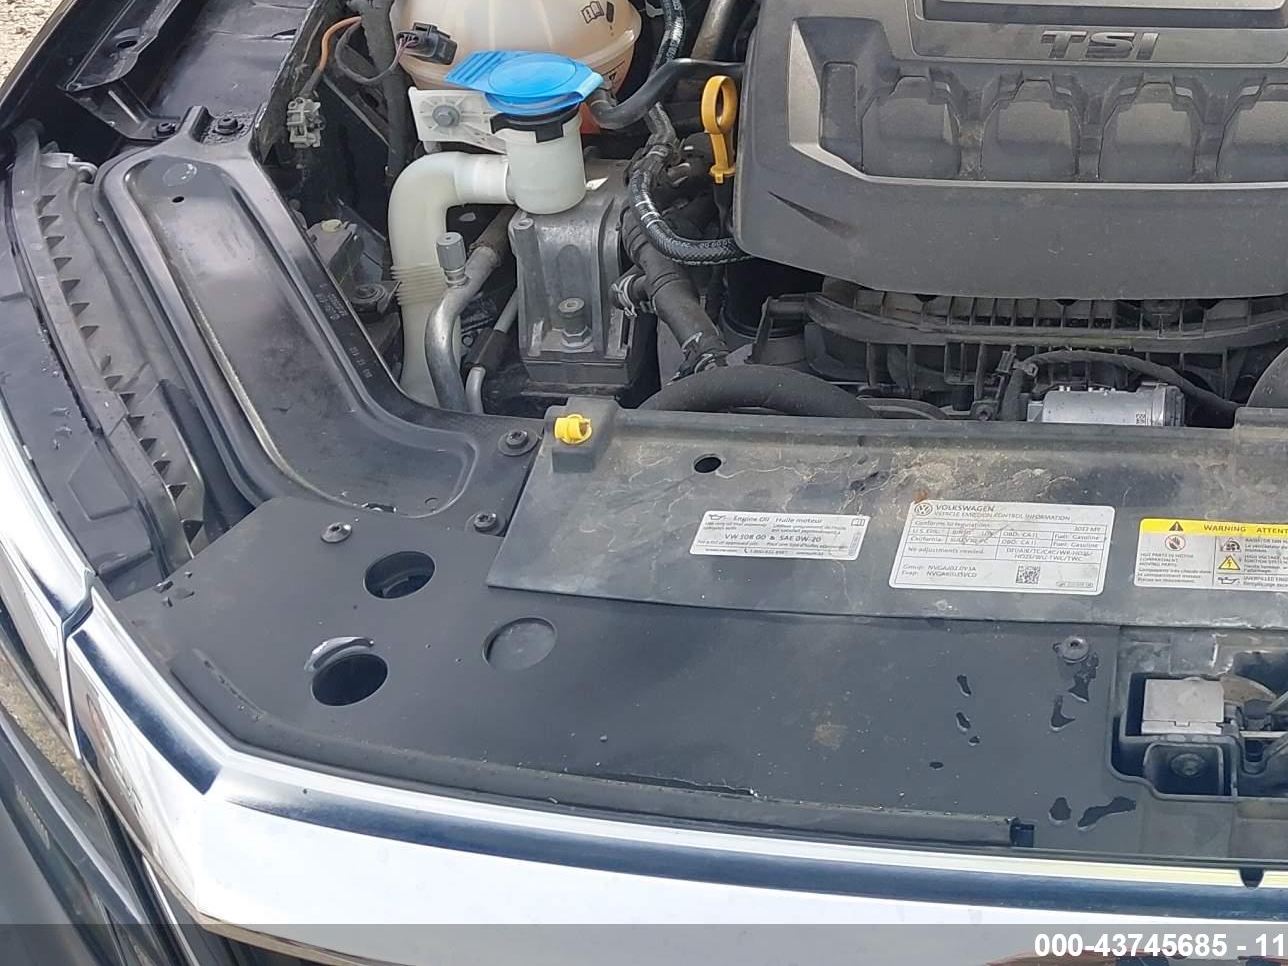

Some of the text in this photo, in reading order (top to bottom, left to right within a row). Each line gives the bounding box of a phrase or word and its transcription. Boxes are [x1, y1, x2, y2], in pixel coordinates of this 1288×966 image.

[1041, 30, 1159, 60] TSI
[936, 504, 995, 512] VOLKSWAGEN
[1203, 524, 1247, 533] WARNING
